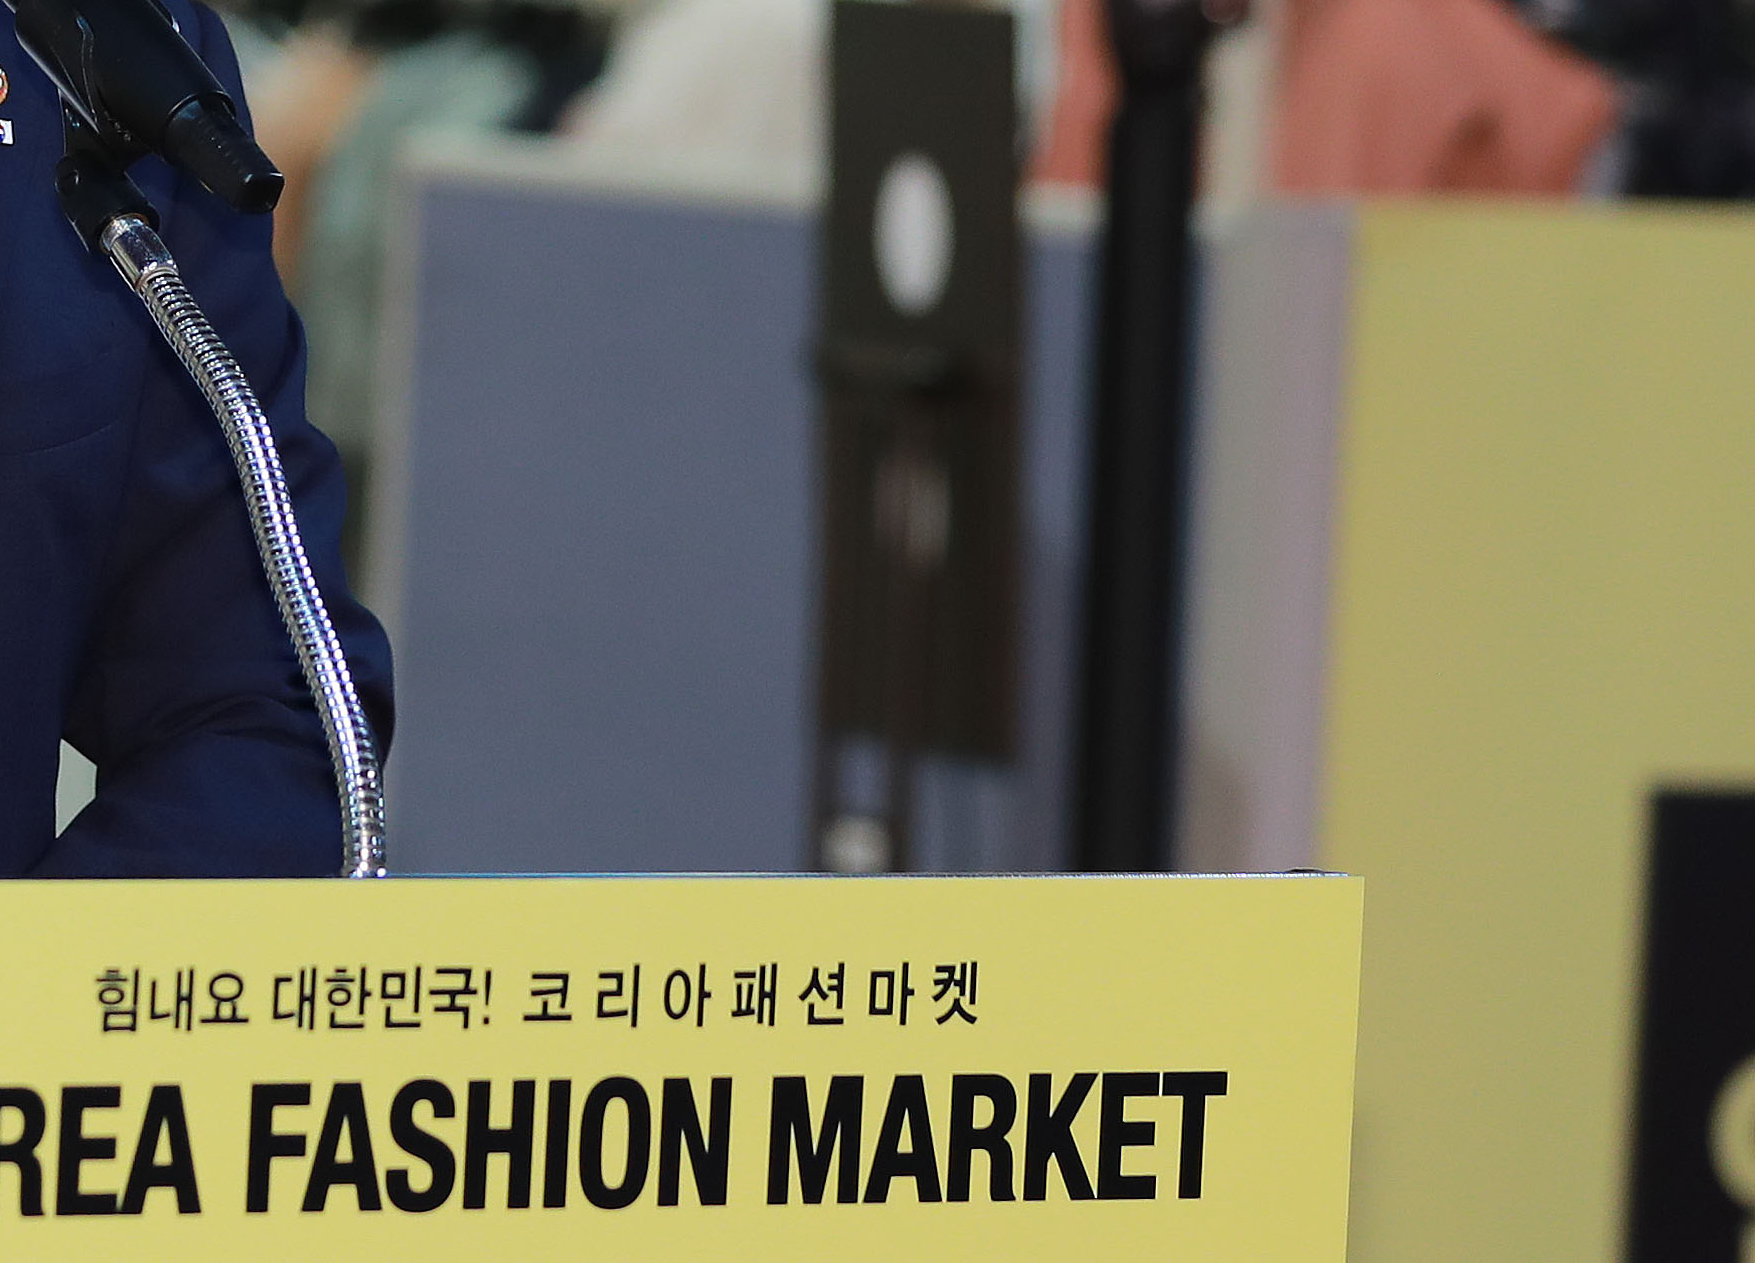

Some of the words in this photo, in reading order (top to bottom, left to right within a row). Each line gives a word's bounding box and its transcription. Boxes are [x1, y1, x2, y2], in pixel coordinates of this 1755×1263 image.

[95, 967, 250, 1033] 힘내요
[271, 965, 492, 1031] 대한민국!
[245, 1074, 733, 1214] FASHION
[766, 1070, 1229, 1206] MARKET
